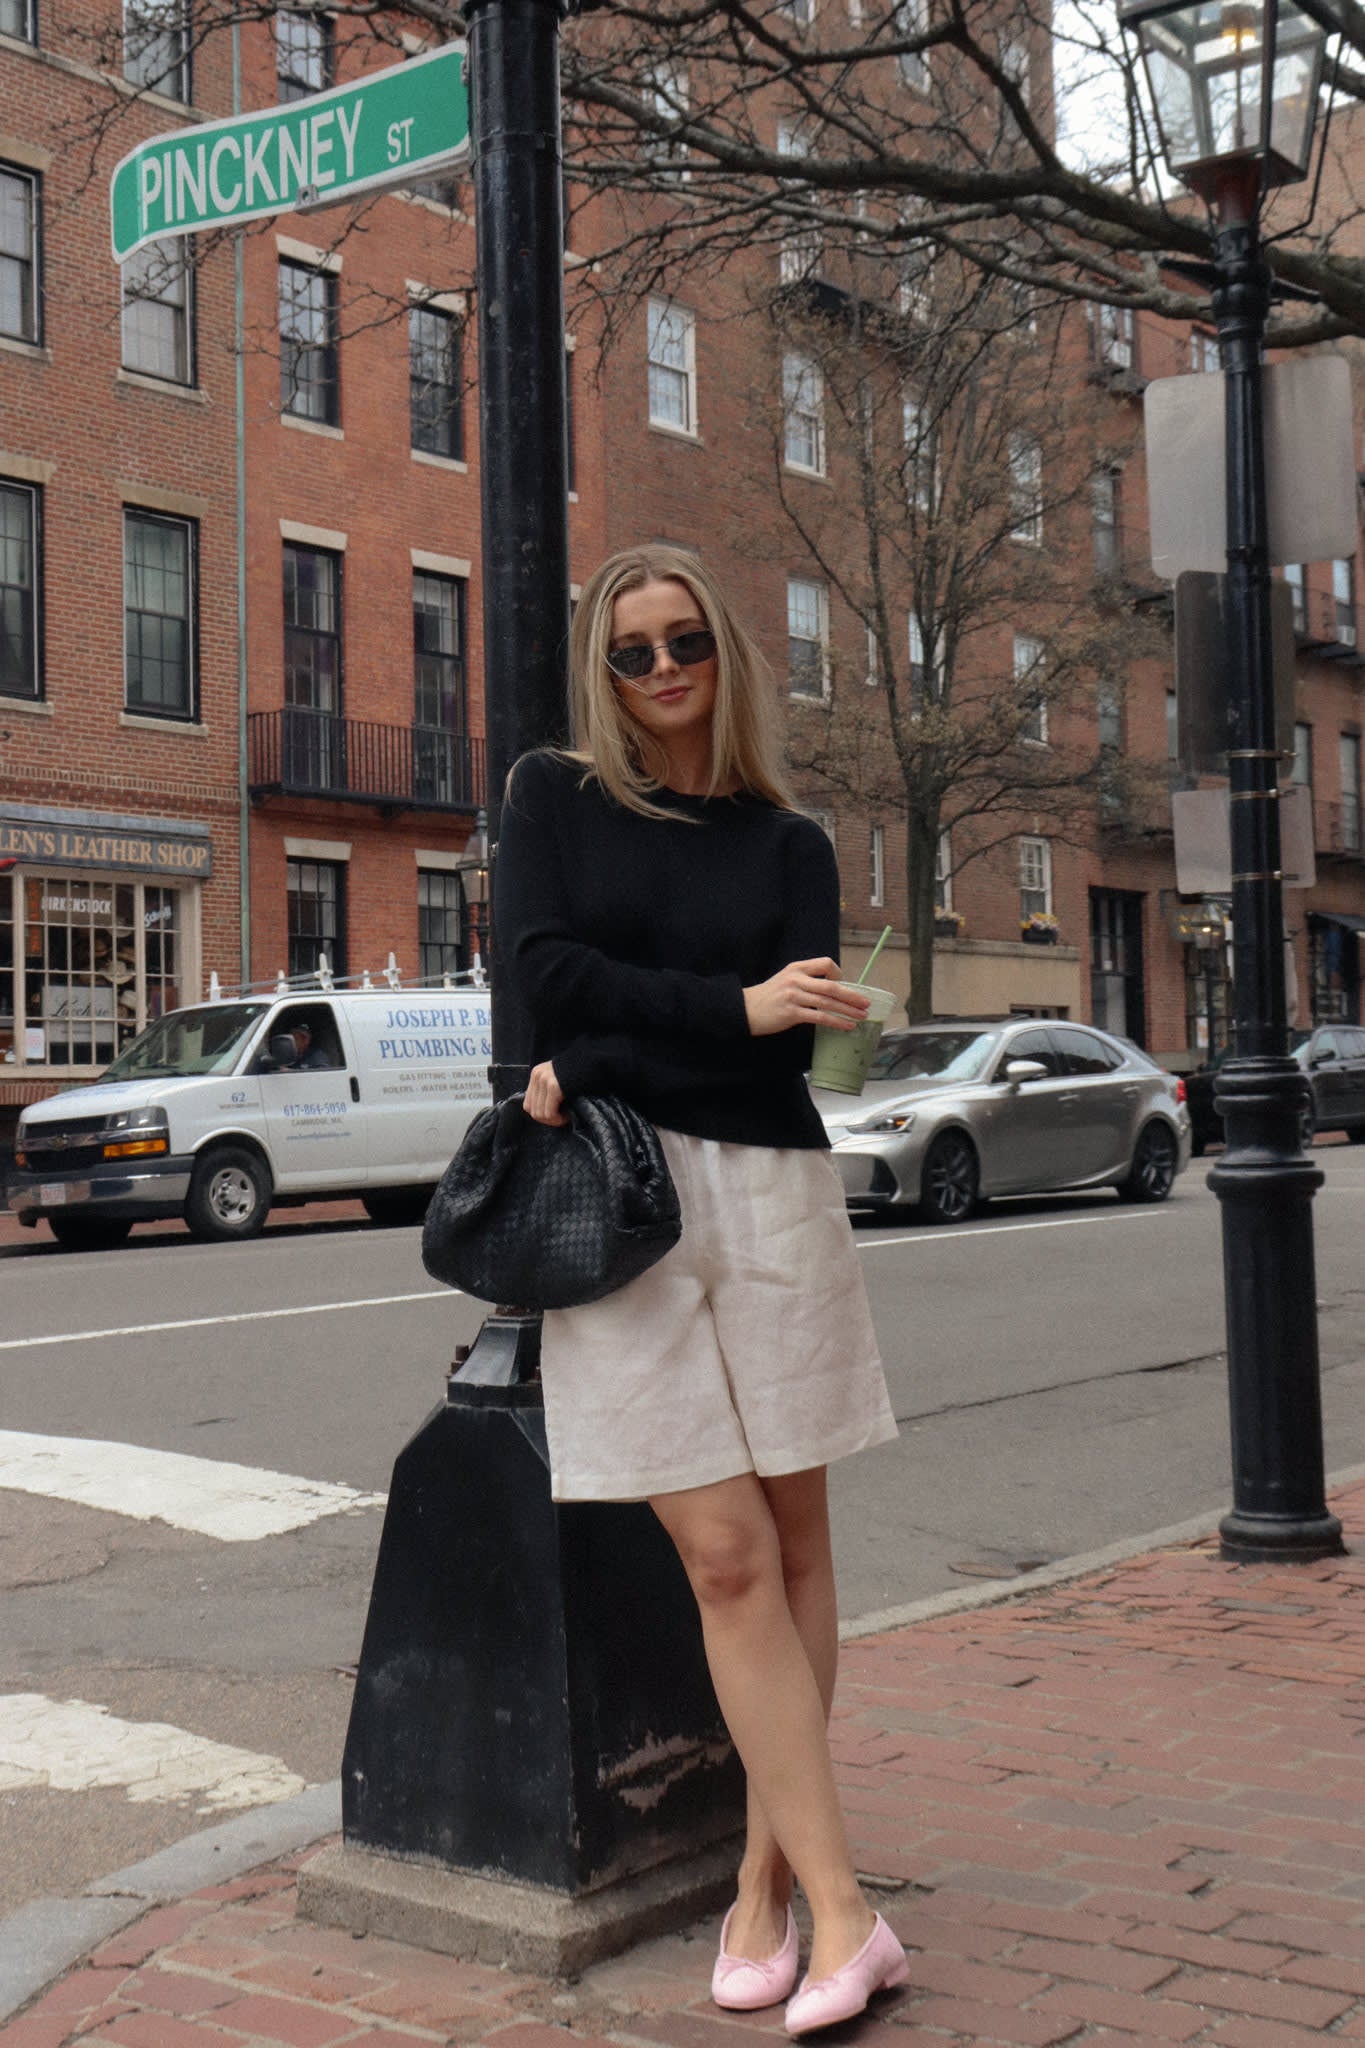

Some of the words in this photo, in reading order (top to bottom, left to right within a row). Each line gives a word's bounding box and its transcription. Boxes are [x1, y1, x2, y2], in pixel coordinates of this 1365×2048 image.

[141, 99, 363, 232] PINCKNEY
[387, 118, 414, 163] ST
[61, 834, 153, 864] LEATHER
[157, 842, 207, 869] SHOP
[386, 1008, 456, 1028] JOSEPH
[458, 1008, 472, 1026] P.
[378, 1037, 476, 1059] PLUMBING
[481, 1038, 492, 1056] &
[231, 1091, 246, 1103] 62
